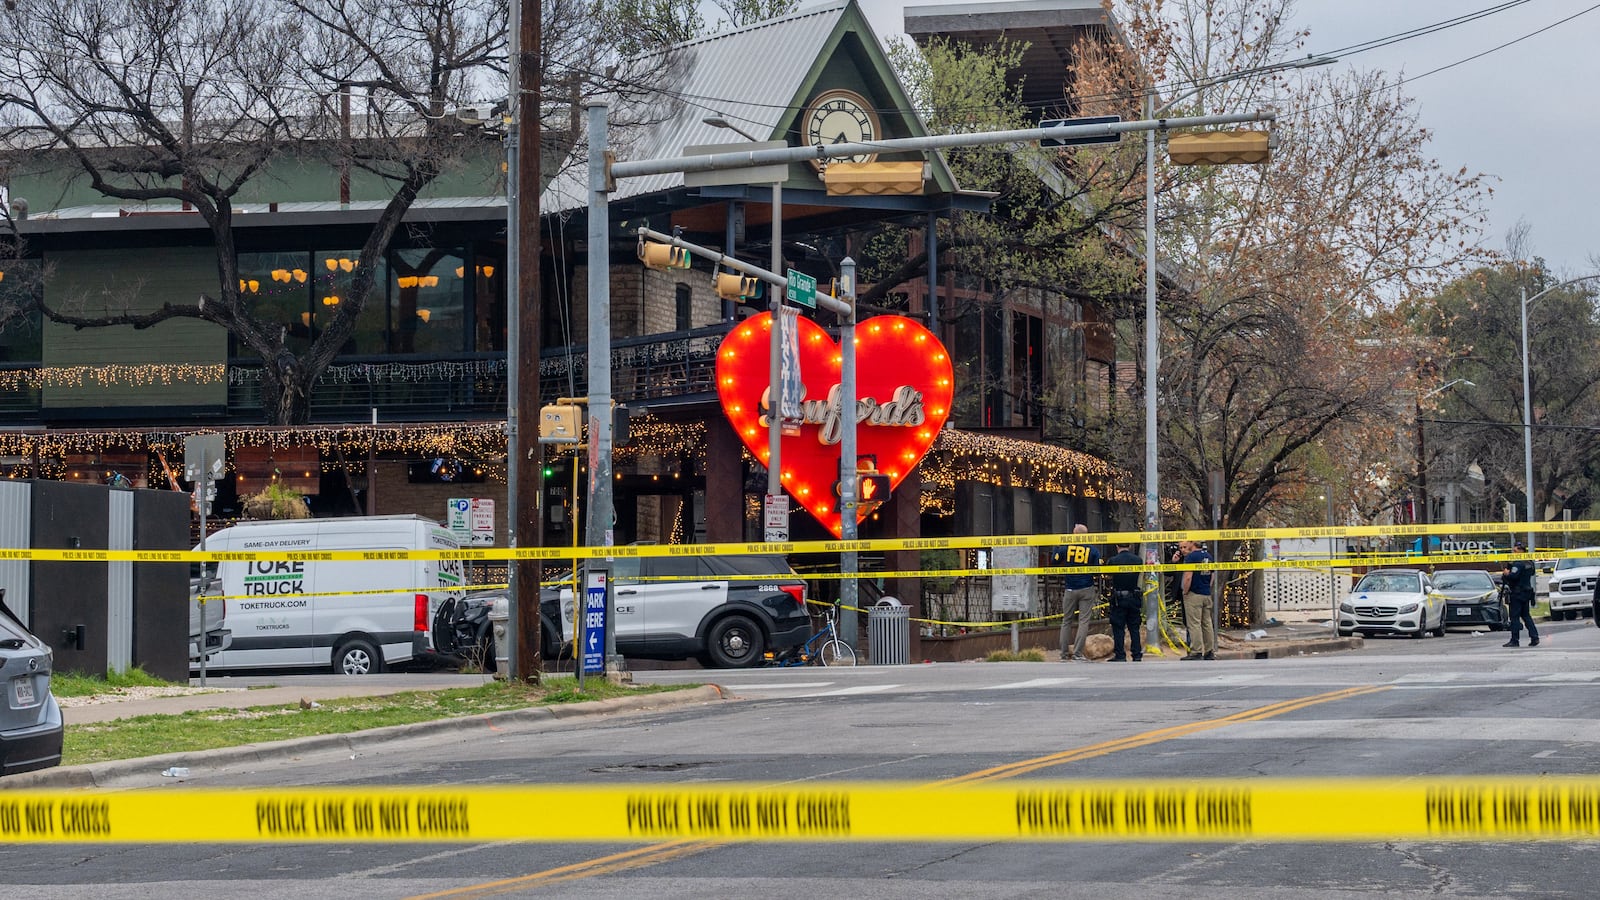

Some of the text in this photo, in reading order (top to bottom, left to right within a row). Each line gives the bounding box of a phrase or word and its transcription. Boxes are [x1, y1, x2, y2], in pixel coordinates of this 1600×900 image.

[797, 274, 811, 292] Grande
[1067, 546, 1091, 564] FBI
[244, 580, 304, 596] TRUCK
[240, 600, 306, 610] TOKETRUCK.COM
[0, 801, 110, 833] DO NOT CROSS
[257, 800, 469, 833] POLICE LINE DO NOT CROSS
[627, 797, 850, 832] POLICE LINE DO NOT CROSS
[1016, 796, 1252, 830] POLICE LINE DO NOT CROSS
[1426, 795, 1483, 829] POLICE
[1494, 795, 1529, 828] LINE
[1539, 794, 1561, 827] DO
